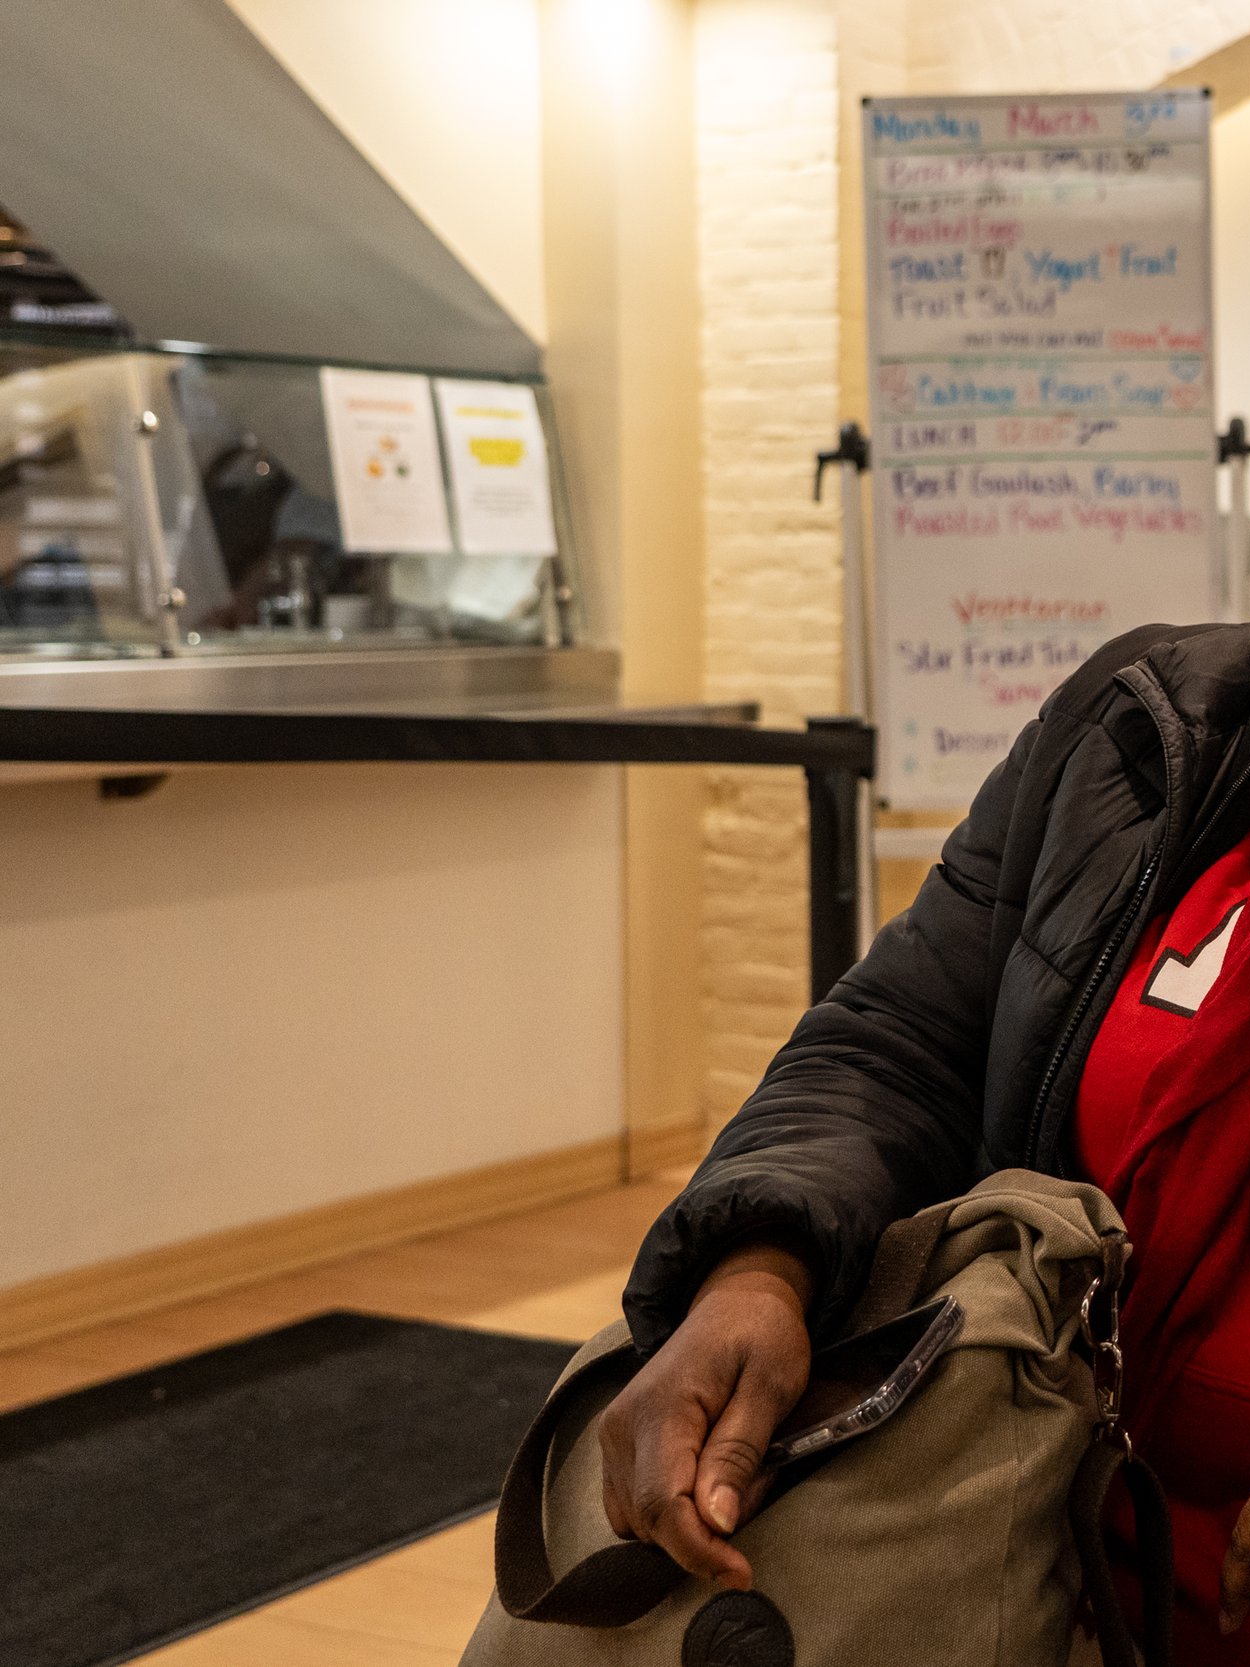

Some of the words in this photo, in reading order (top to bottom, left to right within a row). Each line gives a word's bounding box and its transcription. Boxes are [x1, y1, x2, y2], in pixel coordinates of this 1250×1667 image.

[872, 108, 981, 145] Monday
[1008, 103, 1099, 138] March
[1024, 251, 1101, 293] Yogurt
[893, 289, 966, 319] Fruit
[976, 286, 1057, 317] Salad
[892, 422, 976, 448] LUNCH
